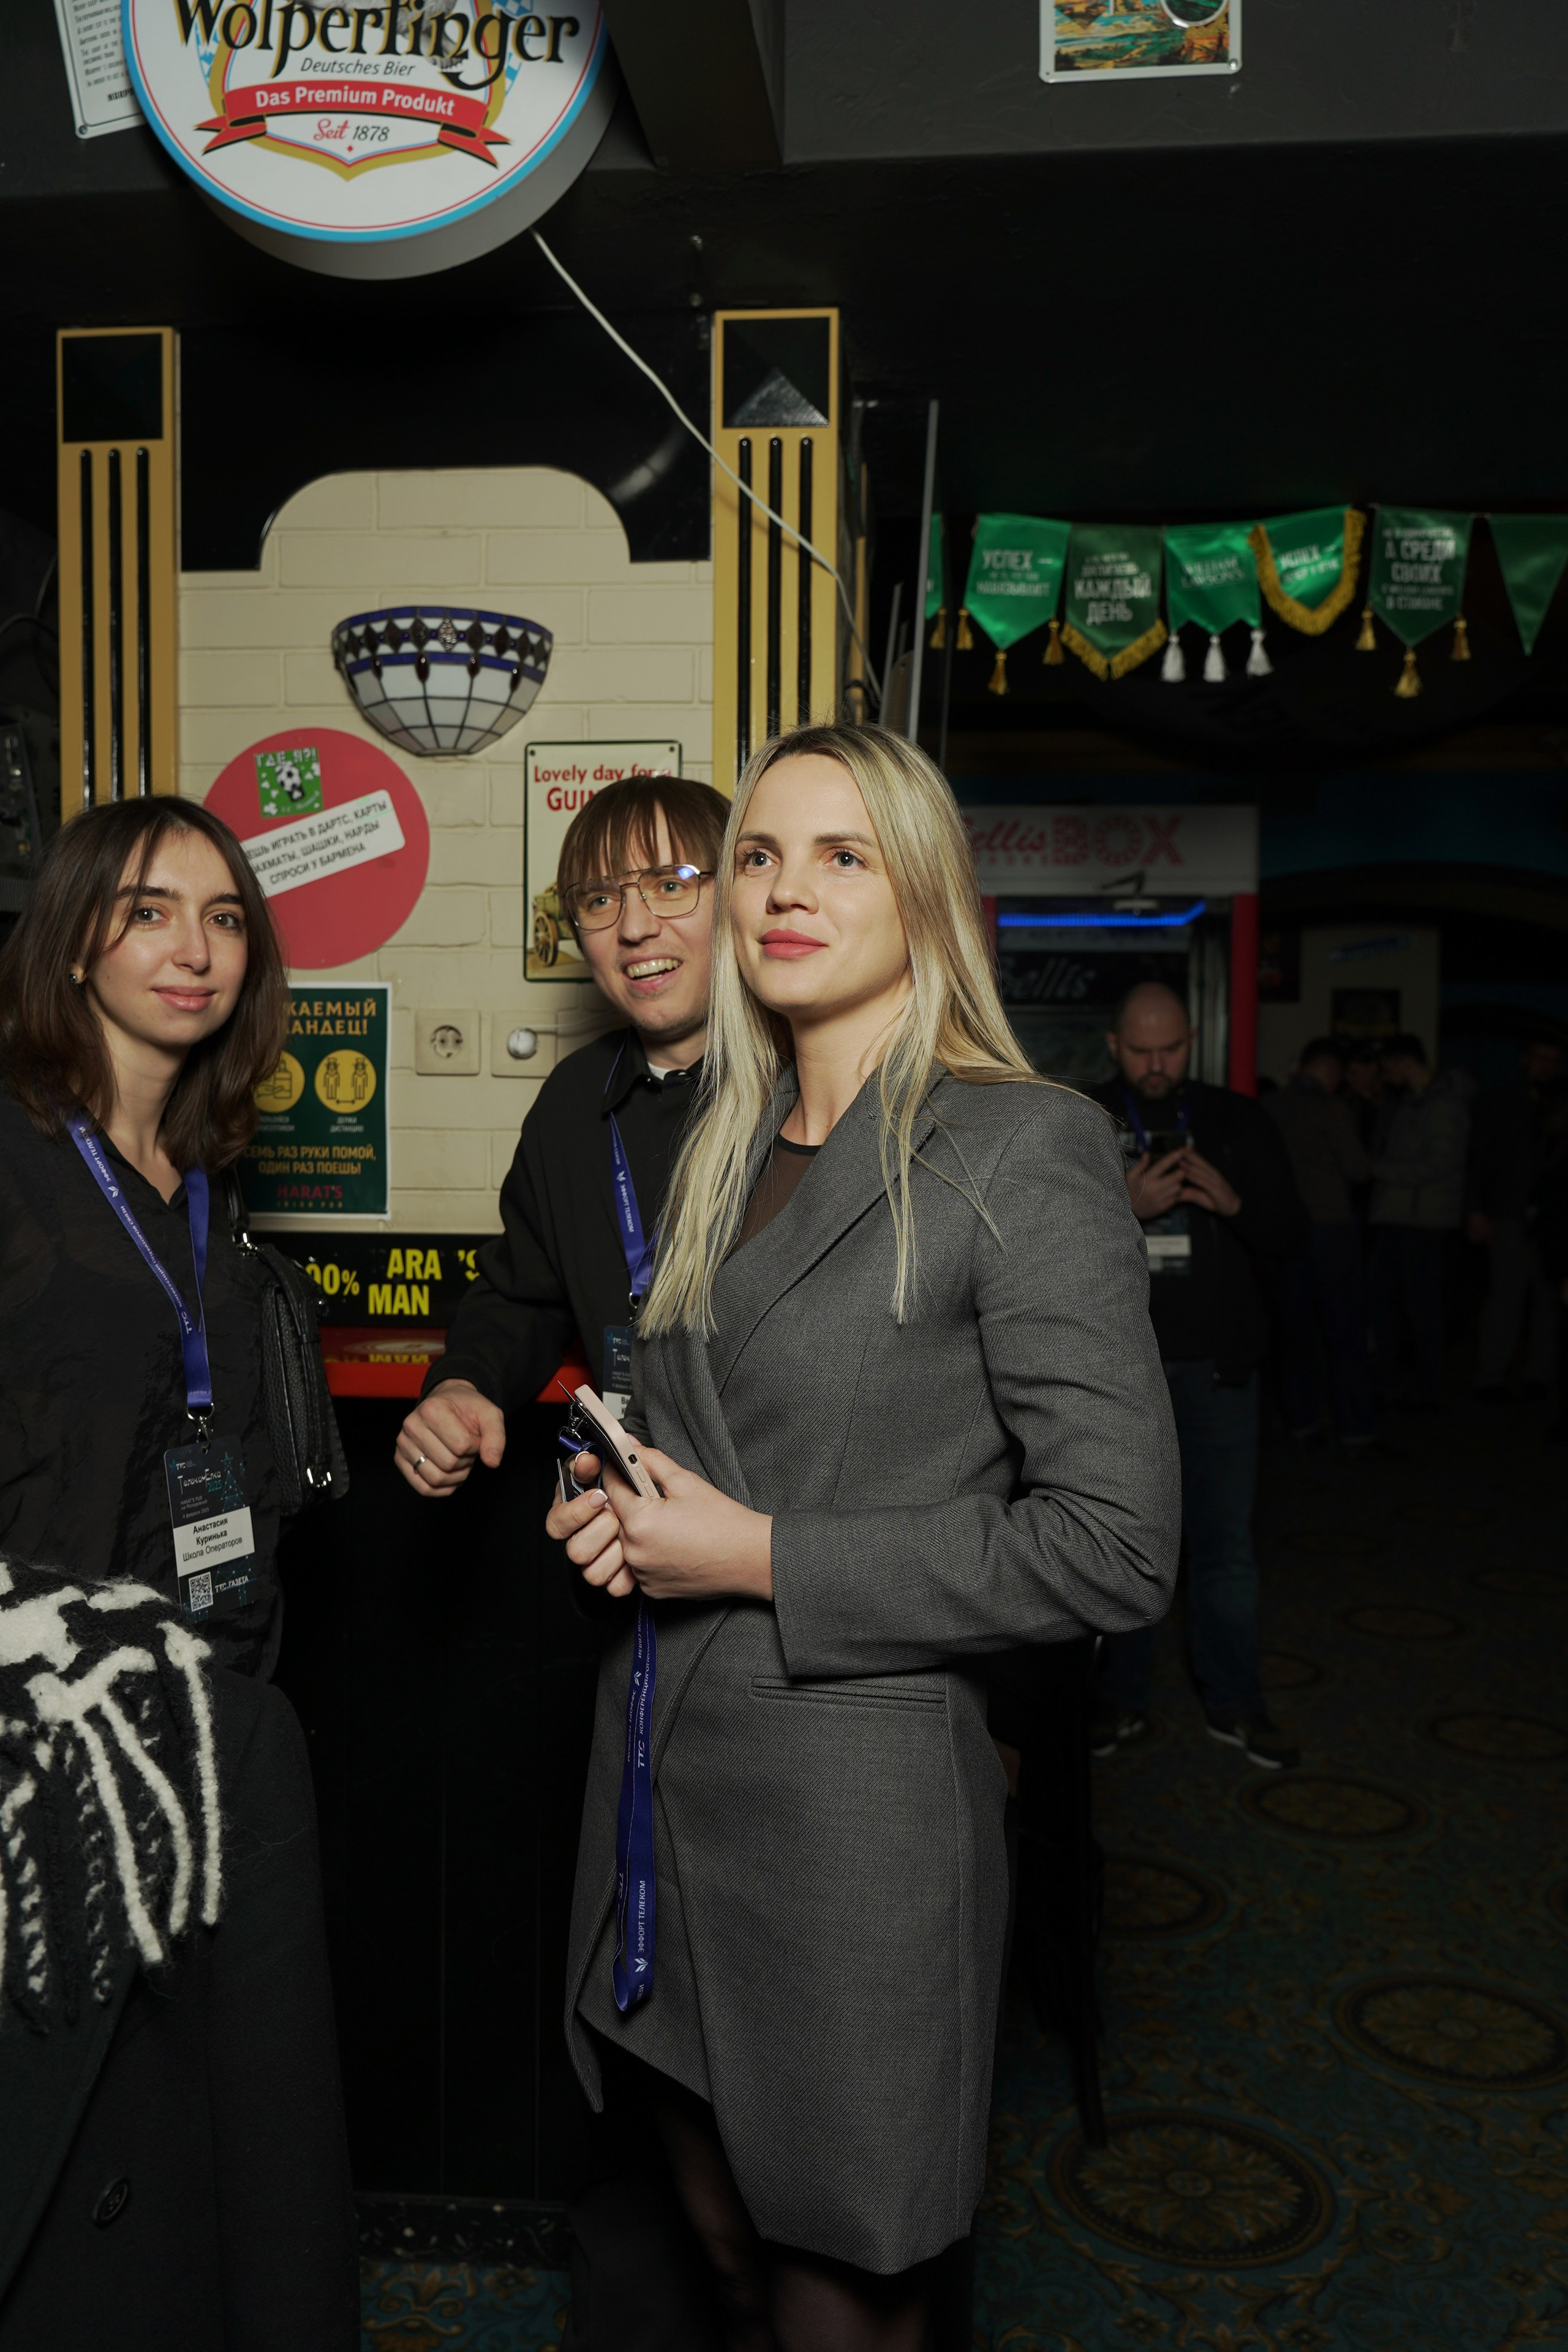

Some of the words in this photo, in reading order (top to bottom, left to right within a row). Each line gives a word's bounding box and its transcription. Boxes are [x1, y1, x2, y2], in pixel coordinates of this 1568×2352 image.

[301, 58, 379, 75] Deutsches
[384, 61, 416, 76] Bier
[255, 88, 291, 107] Das
[295, 86, 378, 105] Premium
[382, 89, 455, 116] Produkt
[313, 119, 350, 141] Seit
[352, 125, 389, 141] 1878
[982, 549, 1033, 570] УСПЕХ
[1074, 572, 1152, 600] КАЖДЫЙ
[1086, 601, 1133, 626] ДЕНЬ
[255, 752, 286, 768] ГДЕ
[293, 747, 317, 763] Я?!
[534, 765, 587, 784] Lovely
[593, 764, 624, 781] day
[631, 763, 655, 777] for
[270, 829, 307, 850] ИГРАТЬ
[308, 826, 316, 837] В
[317, 813, 353, 835] ДАРТС,
[354, 799, 387, 821] КАРТЫ
[254, 851, 300, 874] АХМАТЫ,
[301, 836, 344, 857] ШАШКИ,
[345, 821, 380, 840] НАРДЫ
[963, 815, 1047, 853] ellis
[1051, 813, 1185, 866] BOX
[270, 863, 310, 884] СПРОСИ
[311, 859, 319, 873] У
[320, 842, 367, 867] БАРМЕНА
[285, 1019, 368, 1036] АНДЕЦ!
[329, 1125, 365, 1133] ДИСТАНЦИЮ
[336, 1115, 358, 1124] ДЕРЖИ
[78, 1126, 99, 1158] ТЕЛЕКОМ
[244, 1145, 276, 1158] СЕМЬ
[277, 1145, 298, 1158] РАЗ
[300, 1146, 330, 1159] РУКИ
[331, 1143, 377, 1161] ПОМОЙ,
[94, 1155, 111, 1183] ЭФФОРТ
[258, 1161, 290, 1175] ОДИН
[292, 1161, 314, 1174] РАЗ
[277, 1185, 343, 1199] HARAT'S
[387, 1249, 442, 1281] ARA
[368, 1284, 429, 1315] MAN
[207, 1479, 222, 1493] 2025
[193, 1517, 228, 1534] Анастасия
[195, 1529, 228, 1545] Куринька
[183, 1548, 204, 1562] Школа
[205, 1536, 243, 1555] Операторов
[215, 1575, 249, 1593] ТТС.ГАЗЕТА
[638, 1740, 646, 1768] ТТС
[638, 1880, 646, 1919] ТЕЛЕКОМ
